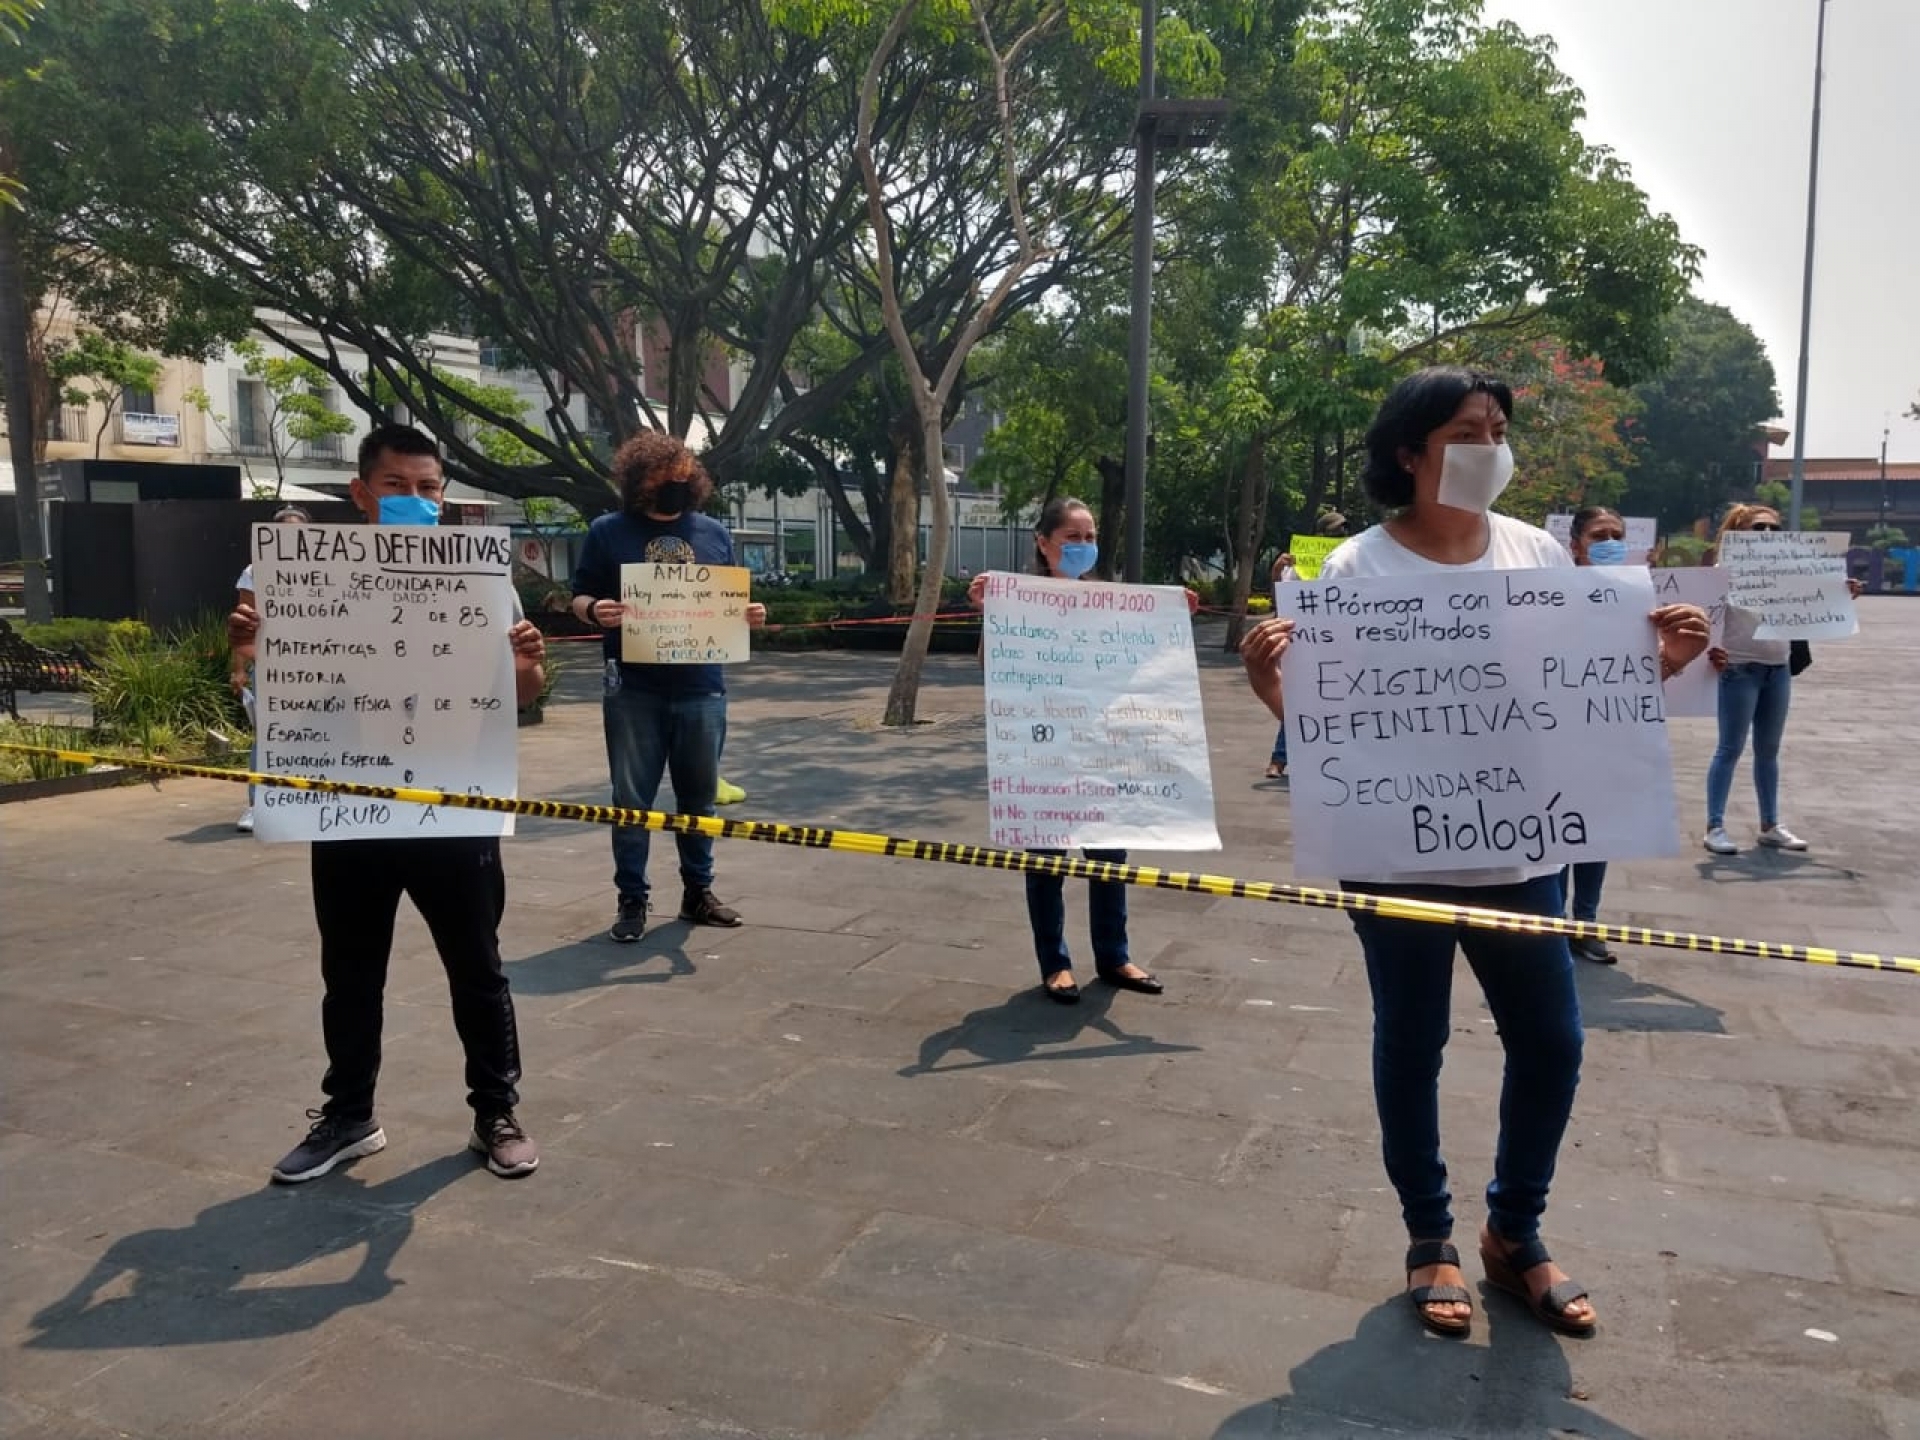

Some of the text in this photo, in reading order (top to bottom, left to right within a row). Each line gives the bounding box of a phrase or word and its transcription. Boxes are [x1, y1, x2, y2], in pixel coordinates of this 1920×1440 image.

[257, 527, 511, 566] PLAZAS DEFINITIVAS
[276, 570, 467, 593] NIVEL SECUNDARIA
[653, 564, 710, 582] AMLO
[265, 585, 294, 597] QUE
[307, 587, 324, 598] SE
[1297, 577, 1619, 626] #Prórroga con base en
[265, 599, 489, 627] BIOLOGÍA 2 DE 85
[723, 602, 740, 617] de
[706, 635, 716, 647] A
[1288, 615, 1492, 645] mis resultados
[433, 644, 453, 656] DE
[266, 668, 346, 684] HISTORIA
[1317, 654, 1656, 701] EXIGIMOS PLAZAS
[268, 695, 346, 713] EDUCACIÓN
[354, 694, 391, 712] FÍSICA
[434, 698, 452, 711] DE
[1298, 693, 1666, 745] DEFINITIVAS NIVEL
[267, 722, 331, 742] ESPAÑOL
[266, 751, 335, 769] EDUCACIÓN
[1321, 756, 1526, 807] SECUNDARIA
[320, 804, 438, 832] GRUPO A
[1412, 792, 1588, 862] Biología
